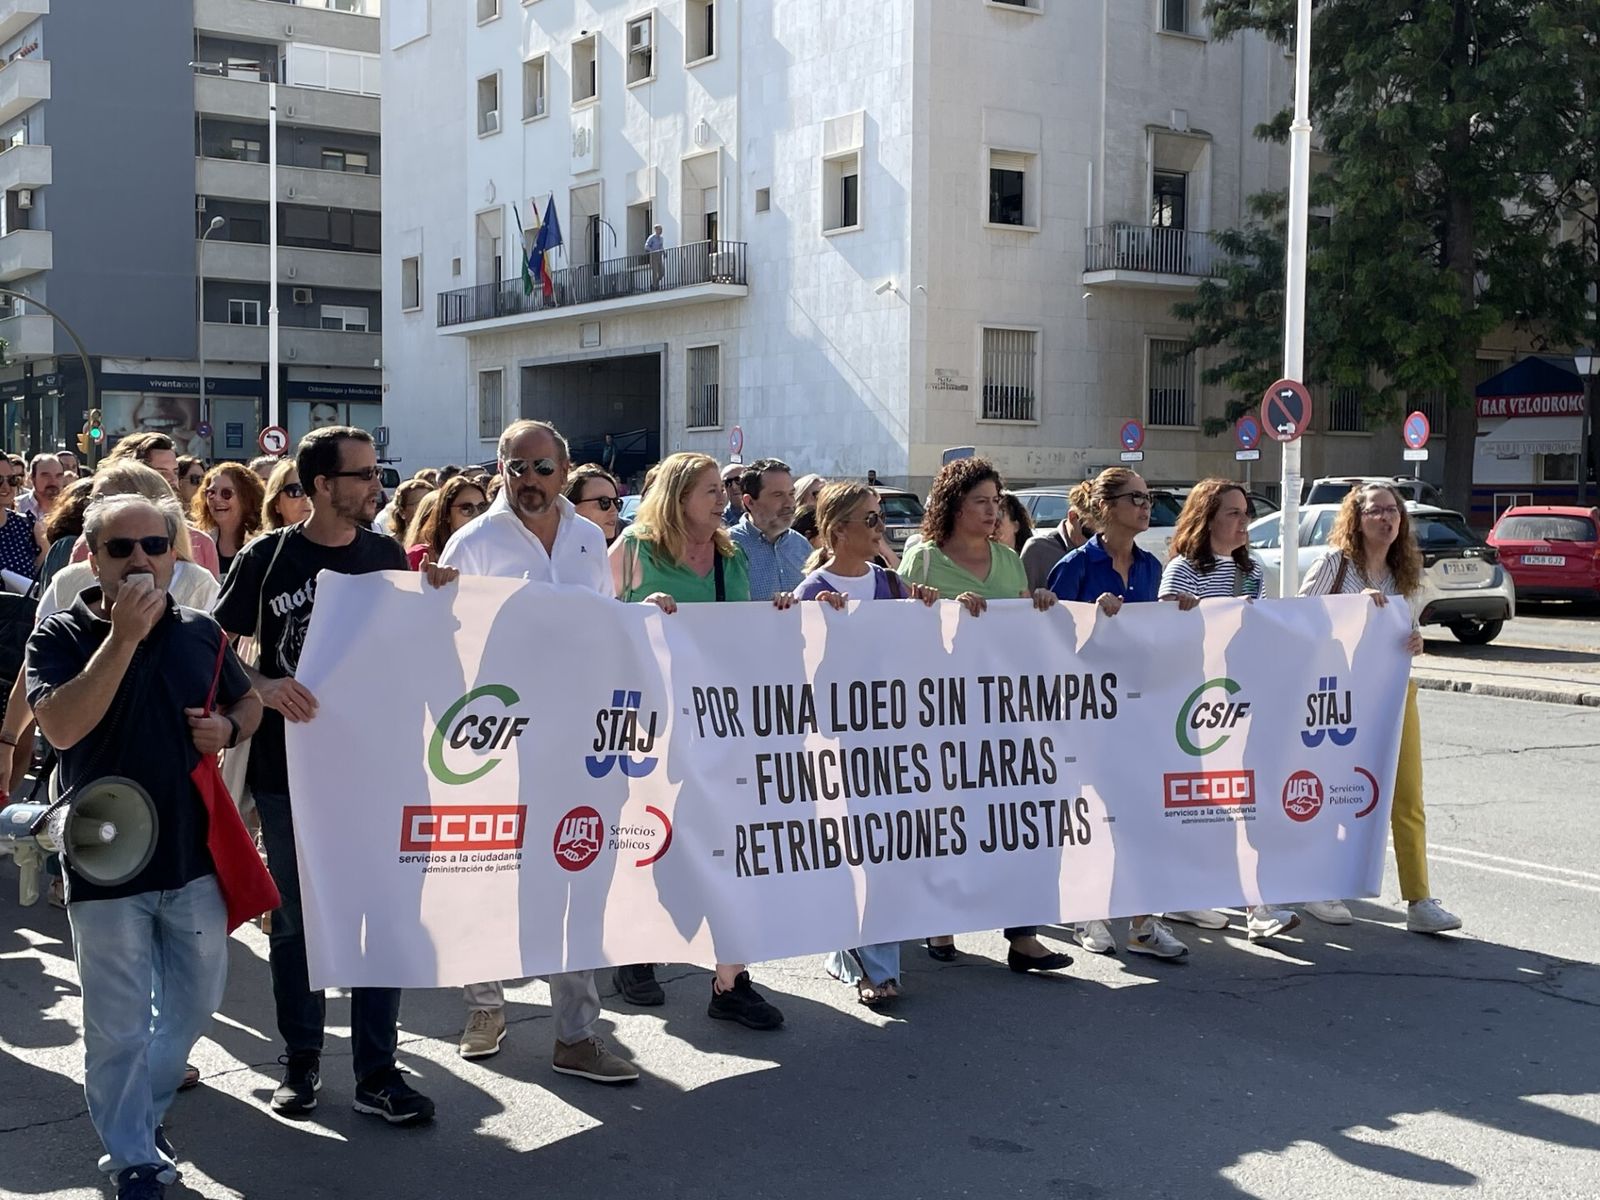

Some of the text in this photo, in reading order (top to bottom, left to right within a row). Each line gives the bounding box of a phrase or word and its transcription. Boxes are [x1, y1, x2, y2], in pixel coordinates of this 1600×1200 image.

[692, 672, 1118, 738] POR UNA LOEO SIN TRAMPAS
[1190, 702, 1251, 730] CSIF
[1306, 691, 1352, 727] STAJ
[450, 714, 530, 750] CSIF
[593, 709, 658, 753] STAJ
[755, 736, 1058, 805] FUNCIONES CLARAS
[1170, 777, 1250, 801] CCOO
[1286, 778, 1320, 797] UGT
[1329, 784, 1365, 793] Servicios
[1329, 794, 1364, 804] Públicos
[1164, 808, 1199, 818] servicios
[1206, 807, 1214, 815] la
[1216, 806, 1256, 815] ciudadanía
[410, 814, 520, 843] CCOO
[562, 816, 600, 838] UGT
[610, 823, 656, 837] Servicios
[735, 797, 1092, 878] RETRIBUCIONES JUSTAS
[609, 837, 651, 850] Públicos
[399, 850, 522, 864] servicios a la ciudadanía
[422, 863, 521, 874] administración de justicia
